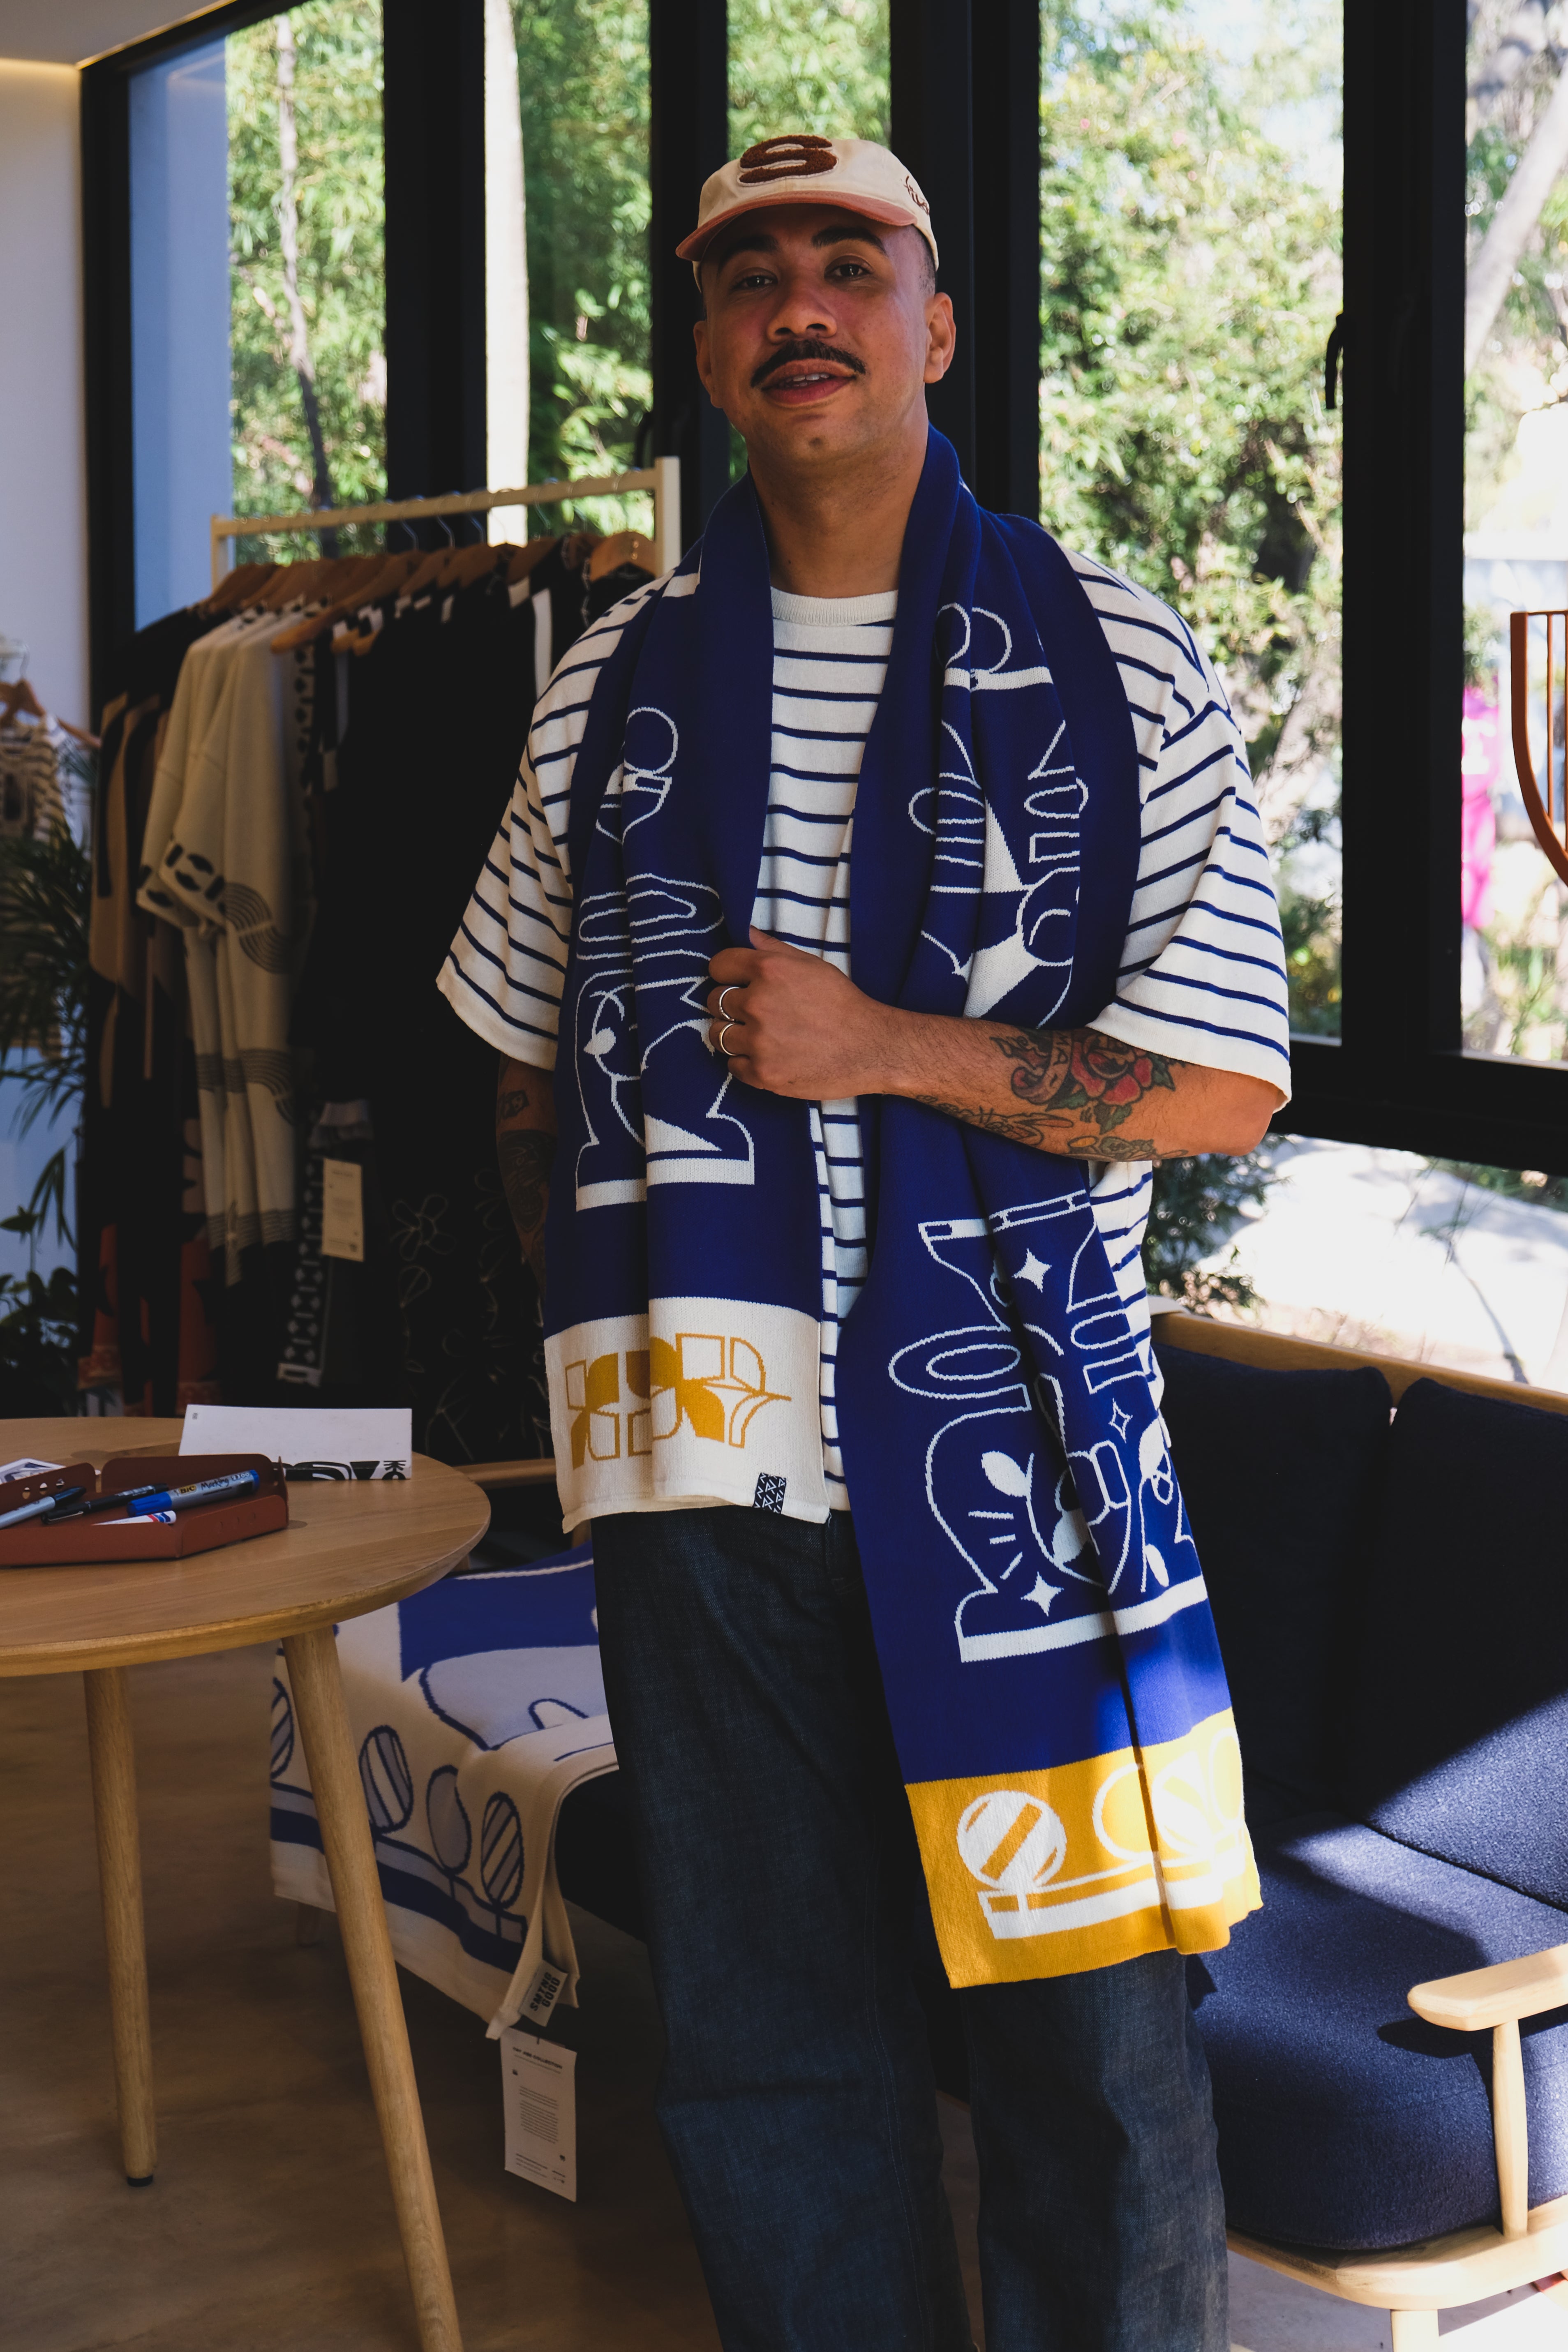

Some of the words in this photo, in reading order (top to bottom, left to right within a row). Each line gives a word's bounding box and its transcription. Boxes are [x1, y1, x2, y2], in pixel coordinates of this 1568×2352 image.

[180, 1485, 195, 1494] BIC
[201, 1478, 229, 1491] Marking
[529, 1972, 552, 2012] SMTNG
[541, 1977, 561, 2008] GOOD
